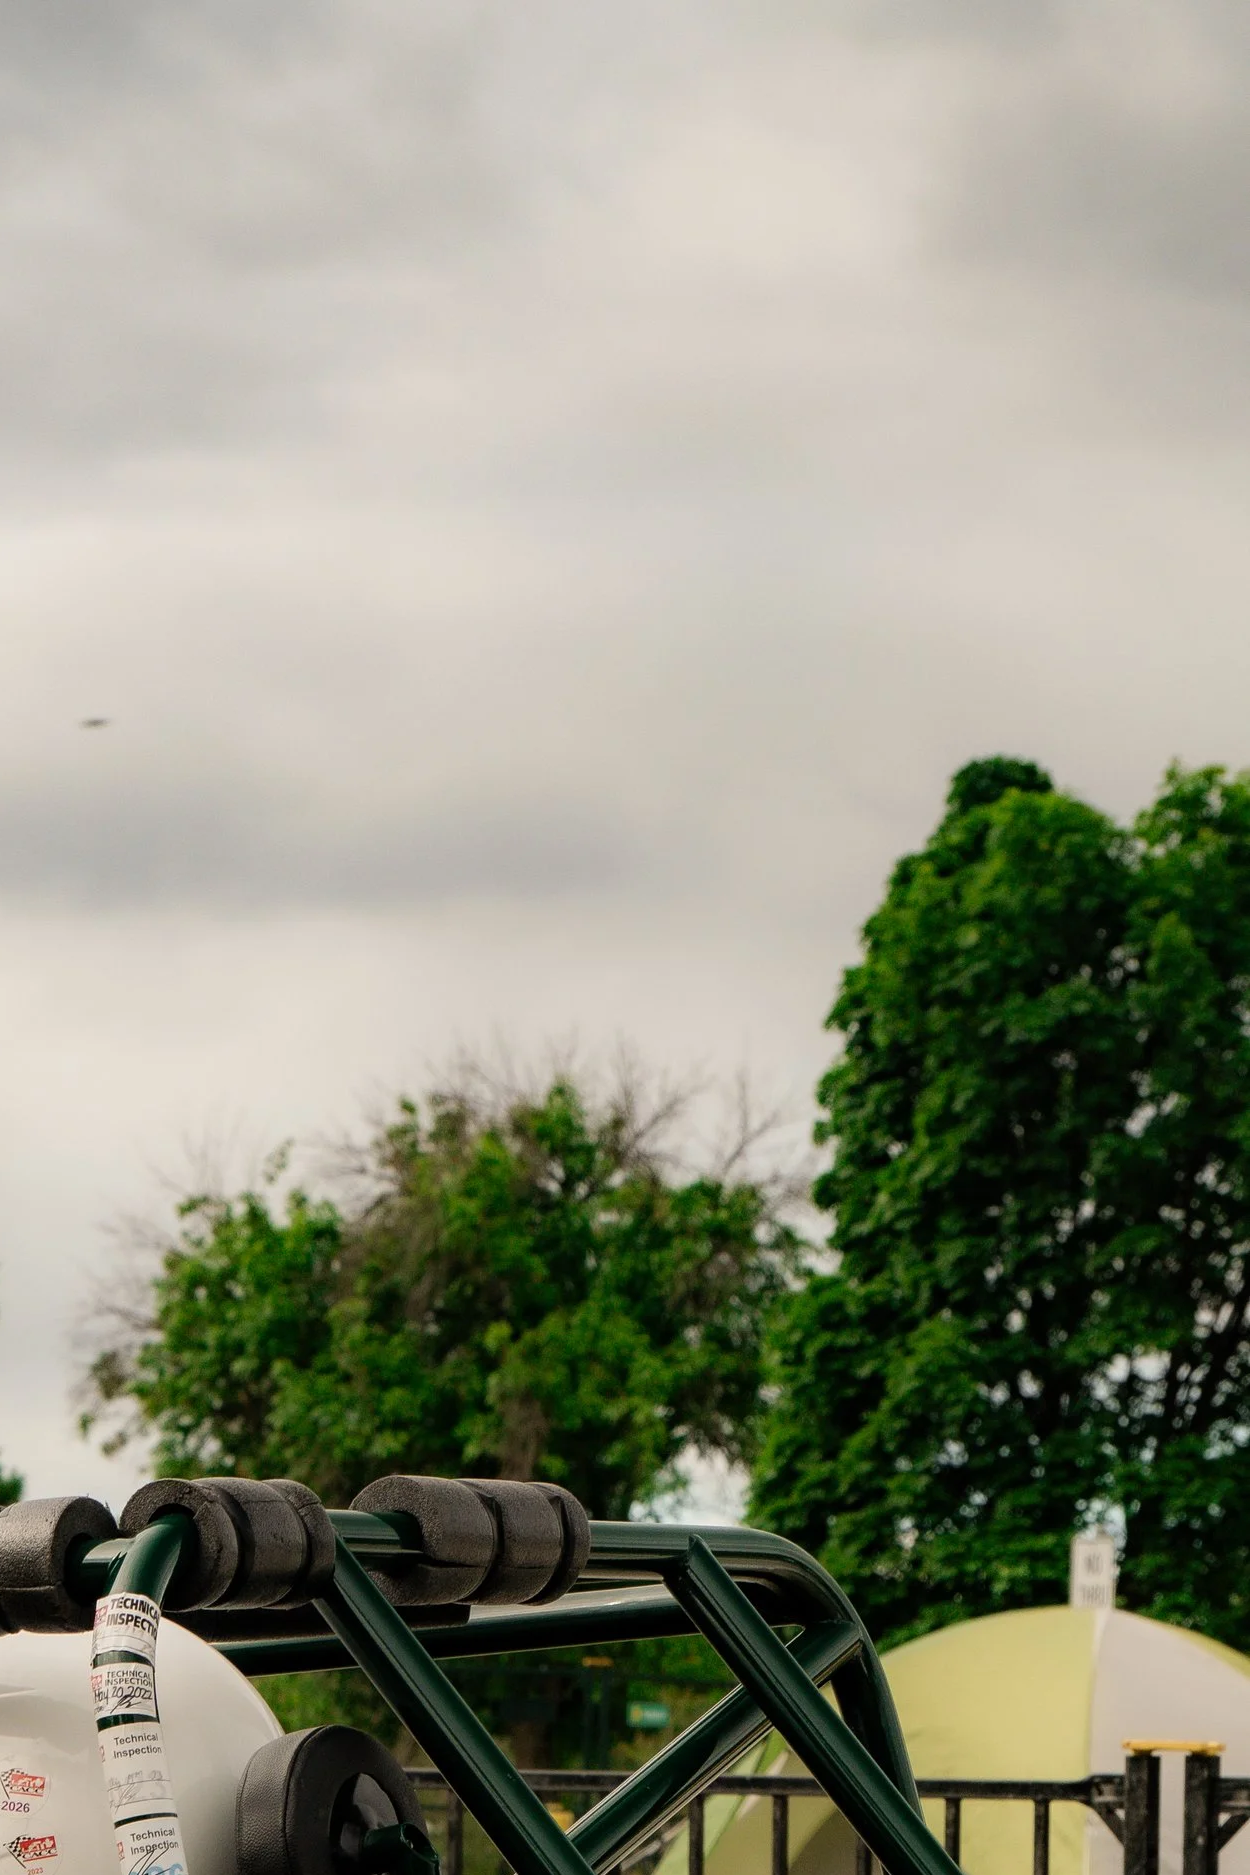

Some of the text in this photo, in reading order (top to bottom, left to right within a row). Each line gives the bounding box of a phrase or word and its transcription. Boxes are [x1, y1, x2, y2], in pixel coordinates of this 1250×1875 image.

[110, 1597, 160, 1621] TECHNICA
[107, 1670, 152, 1680] TECHNICAL
[105, 1677, 152, 1688] INSPECTION
[128, 1685, 152, 1700] 2022
[114, 1733, 158, 1746] Technical
[113, 1745, 162, 1759] Inspection
[1, 1800, 30, 1813] 2026
[131, 1828, 175, 1842] Technical
[131, 1840, 179, 1855] Inspection
[27, 1868, 44, 1875] 2023
